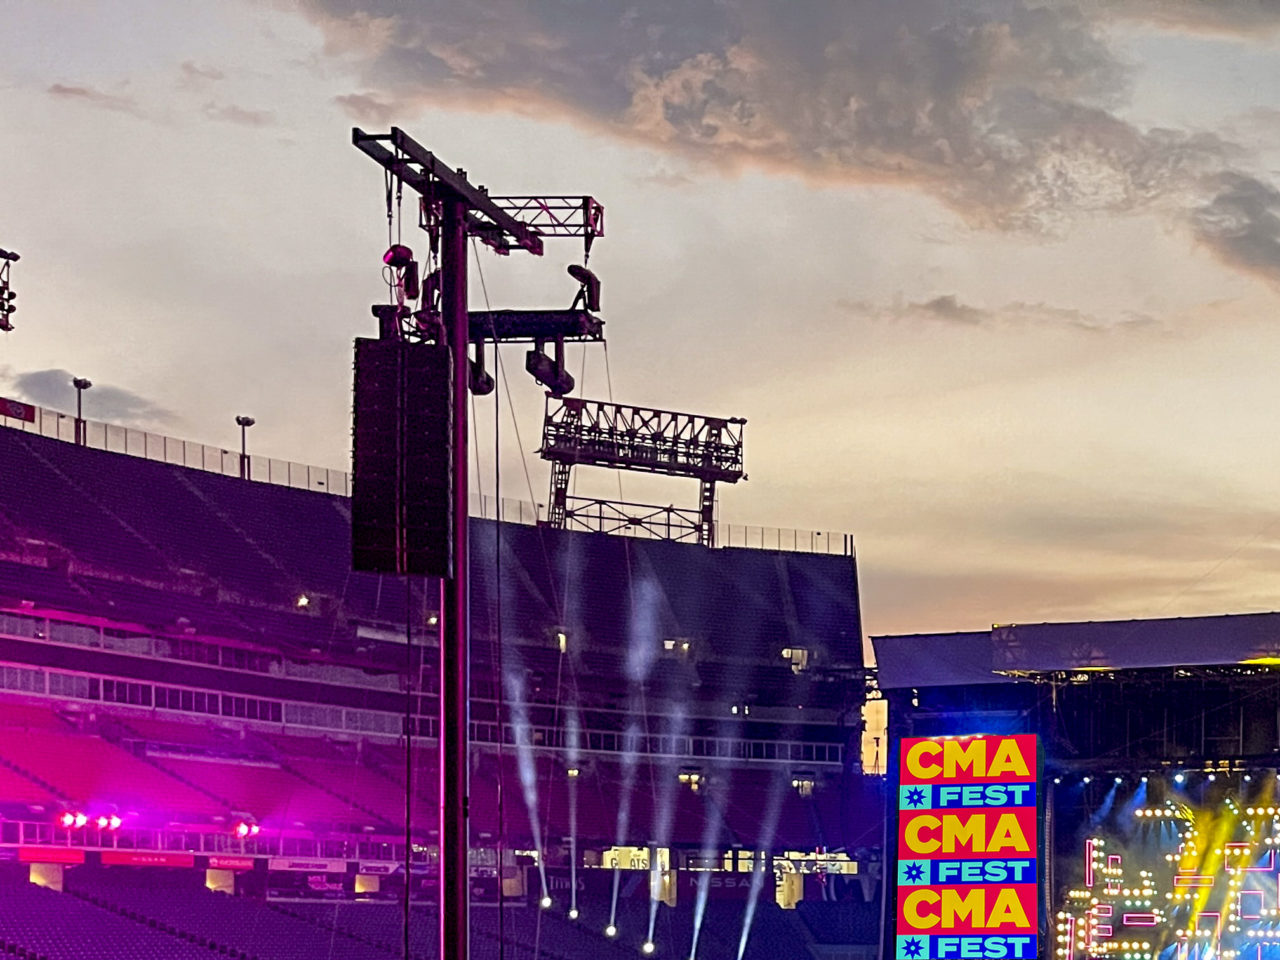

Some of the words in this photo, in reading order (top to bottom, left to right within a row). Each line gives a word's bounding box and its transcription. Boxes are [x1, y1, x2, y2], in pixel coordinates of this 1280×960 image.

[906, 739, 1031, 779] CMA
[939, 785, 1030, 807] FEST
[904, 813, 1031, 854] CMA
[938, 860, 1030, 882] FEST
[903, 888, 1031, 929] CMA
[937, 936, 1031, 958] FEST
